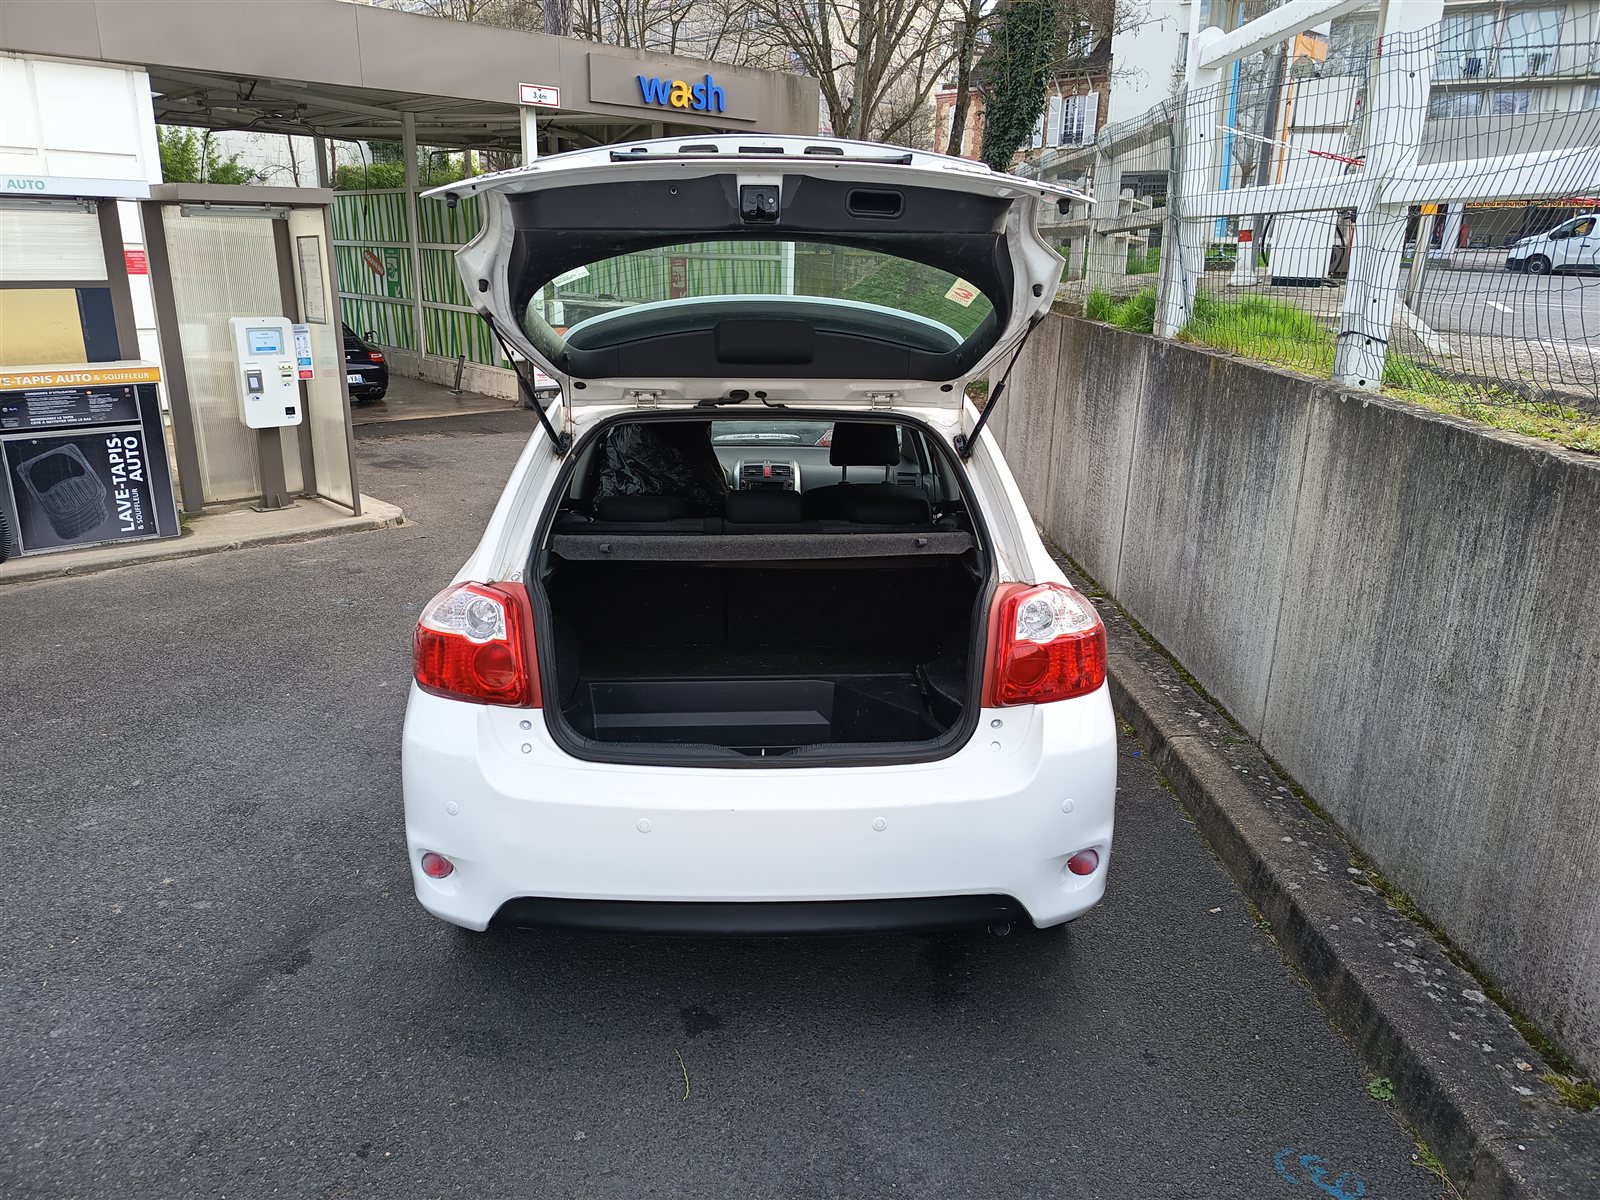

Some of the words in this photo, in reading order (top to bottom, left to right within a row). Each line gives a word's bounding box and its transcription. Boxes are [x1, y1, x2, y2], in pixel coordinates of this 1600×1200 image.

[637, 74, 725, 112] wash
[7, 179, 45, 191] AUTO
[56, 374, 92, 384] AUTO
[103, 372, 150, 380] SOUFFLEUR
[123, 436, 144, 482] AUTO
[106, 437, 136, 532] LAVE-TAPIS
[131, 488, 144, 524] SOUFFLEUR
